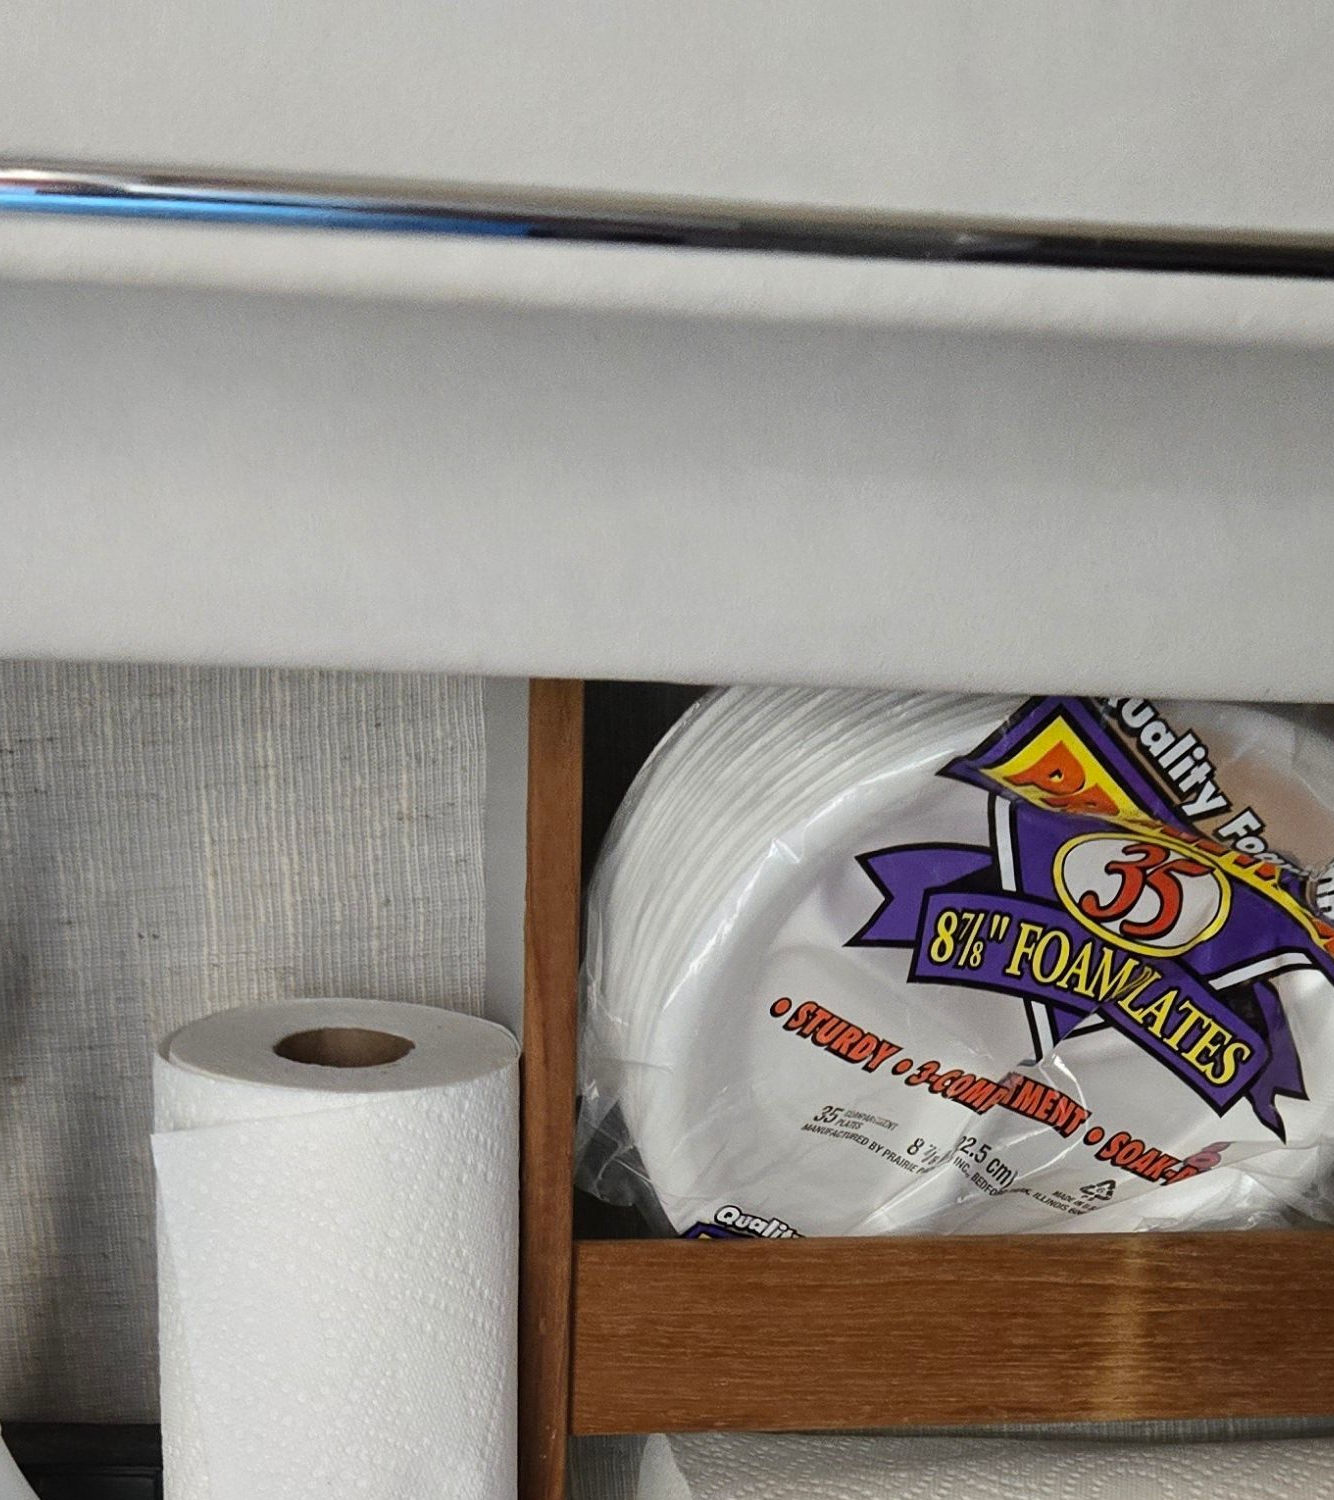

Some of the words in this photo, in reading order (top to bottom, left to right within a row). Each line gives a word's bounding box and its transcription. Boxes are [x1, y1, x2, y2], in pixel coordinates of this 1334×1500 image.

[1107, 697, 1230, 820] uality
[1077, 843, 1214, 938] 35
[783, 1001, 903, 1073] STURDY
[801, 1123, 869, 1146] MANUFACTURED
[868, 1141, 884, 1157] BY
[882, 1149, 918, 1174] PRAIRIE
[813, 1105, 844, 1124] 35
